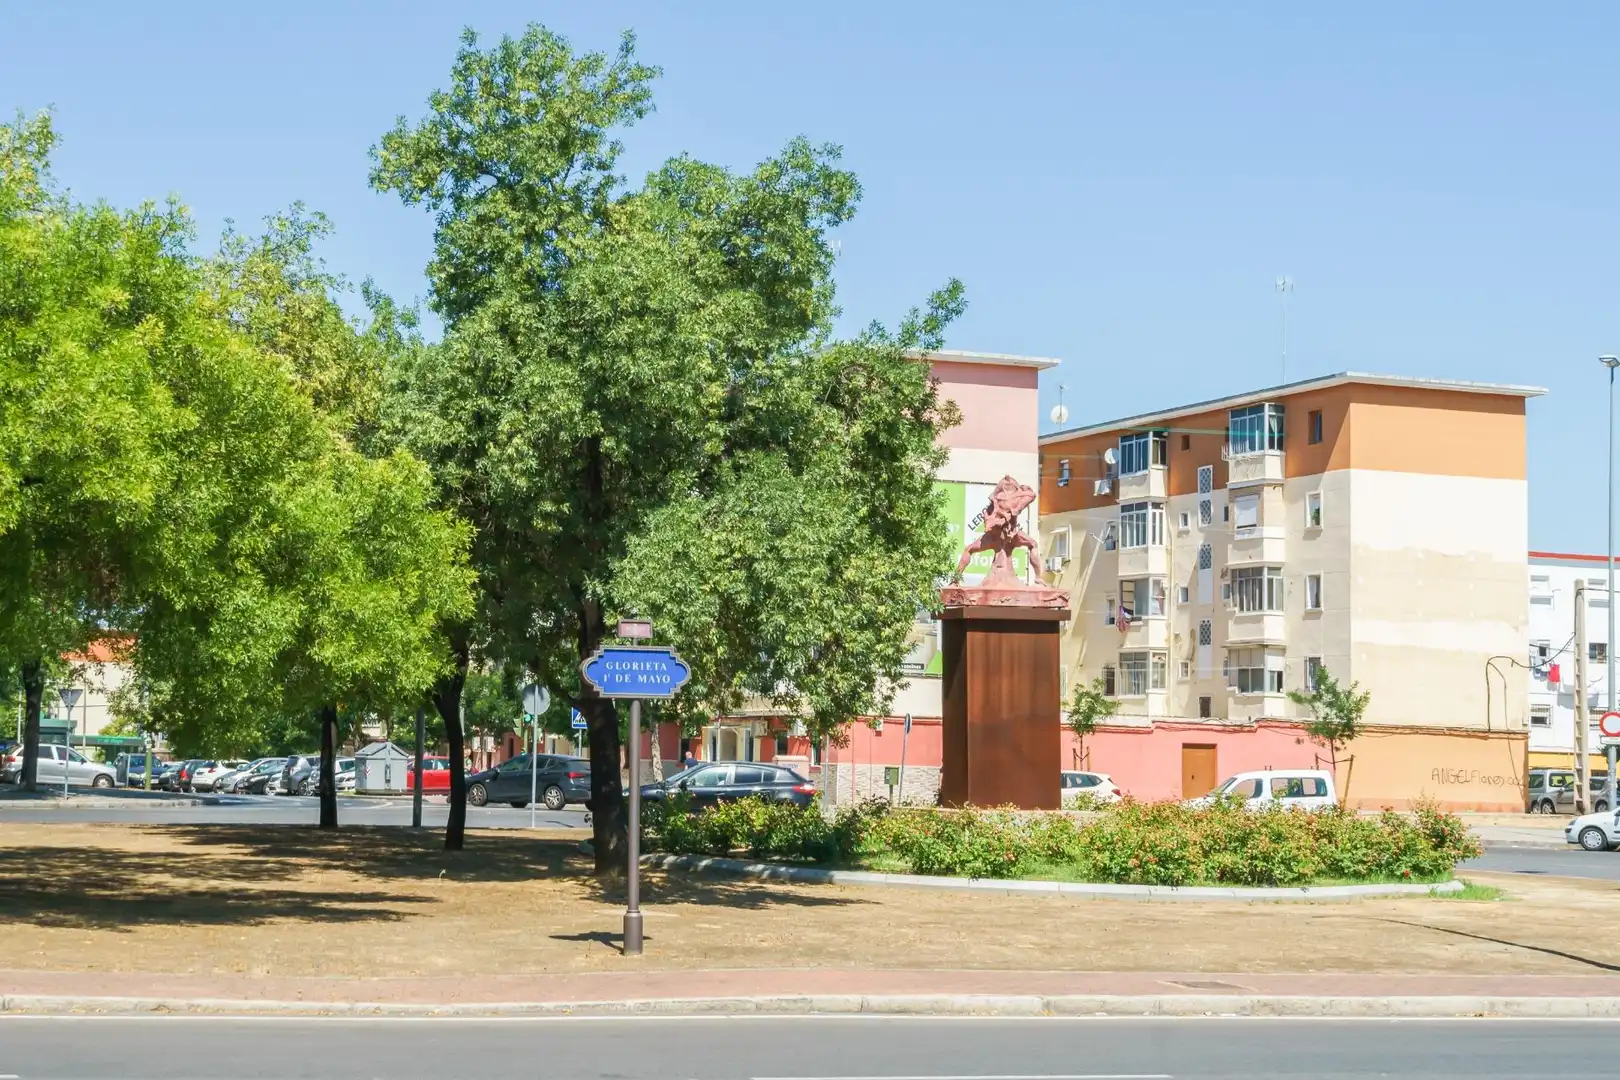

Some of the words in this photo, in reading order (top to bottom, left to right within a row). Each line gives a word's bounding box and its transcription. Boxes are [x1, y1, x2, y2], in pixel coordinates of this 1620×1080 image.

[606, 661, 667, 671] GLORIETA
[615, 673, 632, 683] DE
[637, 674, 671, 684] MAYO
